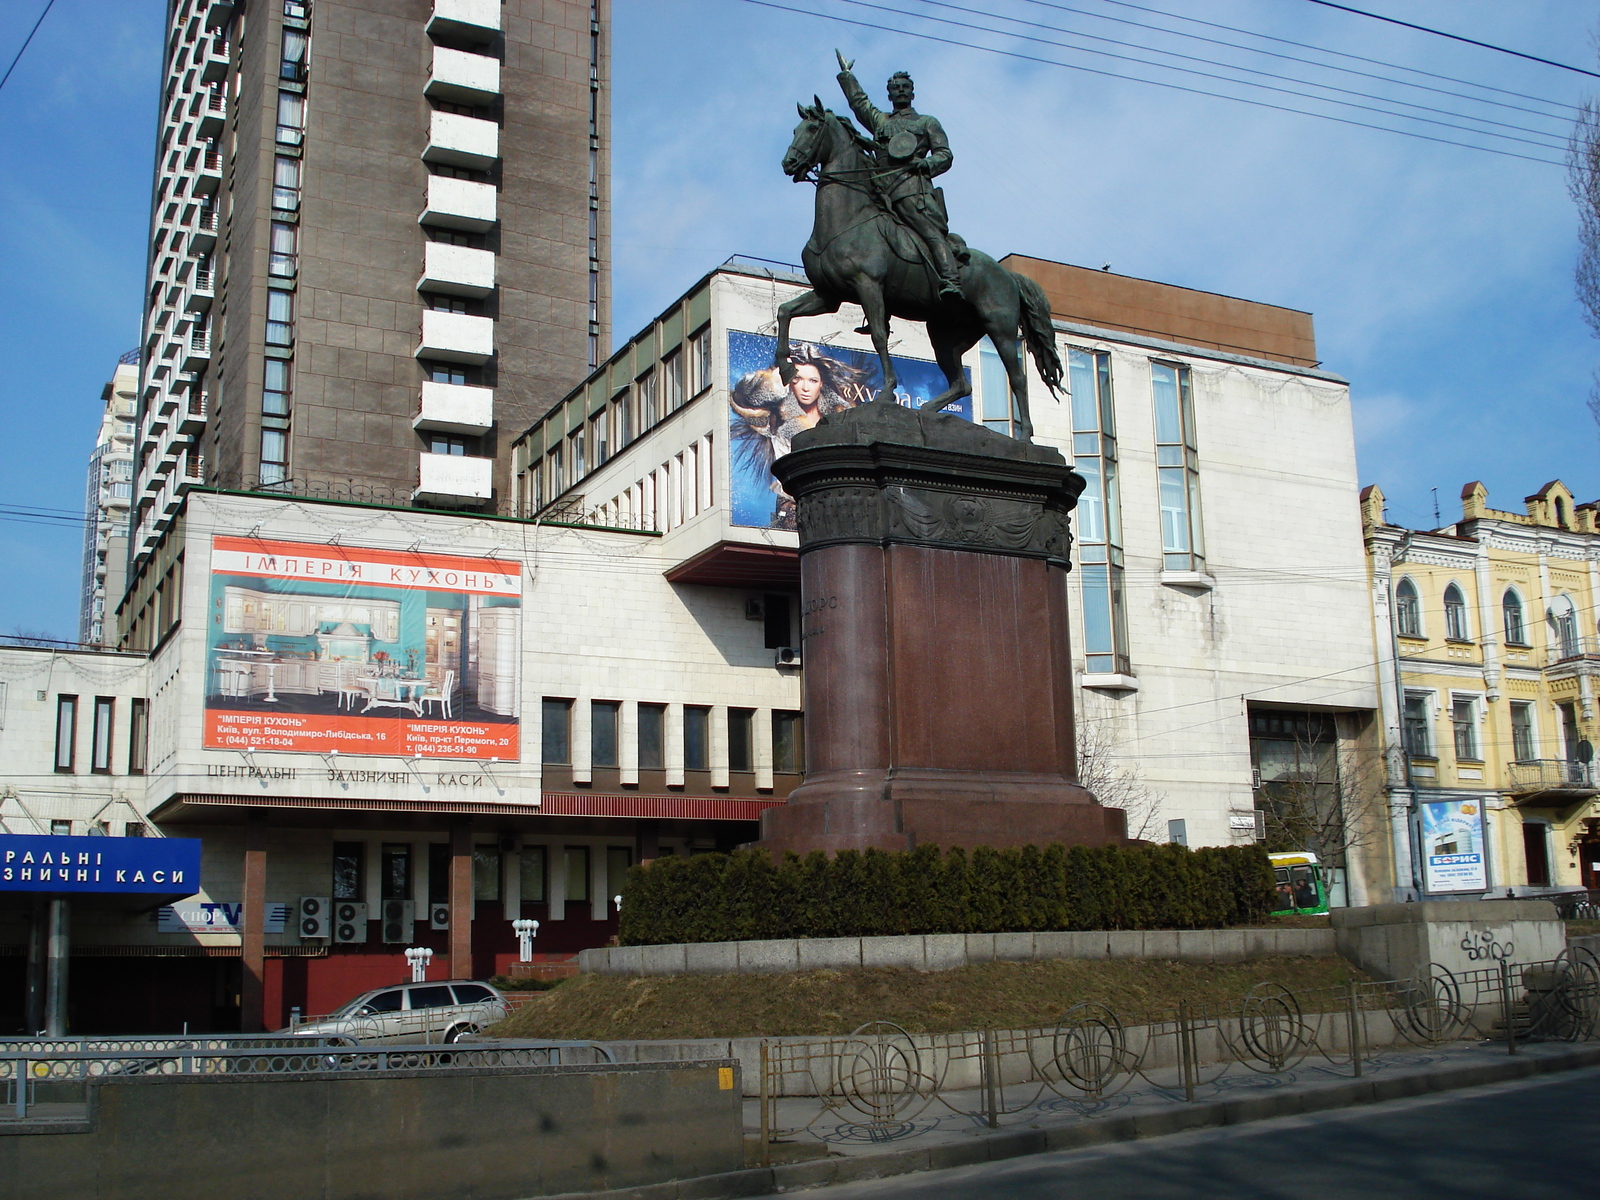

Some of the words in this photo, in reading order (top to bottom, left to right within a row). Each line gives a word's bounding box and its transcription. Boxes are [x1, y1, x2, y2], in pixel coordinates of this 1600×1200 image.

[245, 555, 362, 578] ІМПЕРІЯ
[390, 567, 494, 589] КУХОНЬ
[217, 725, 240, 735] Київ,
[242, 728, 262, 737] вул.
[264, 727, 374, 741] Володимиро-Либідська,
[375, 732, 386, 741] 16
[406, 734, 428, 743] Київ,
[430, 736, 452, 744] пр-кт
[454, 735, 497, 746] Перемоги,
[499, 738, 509, 746] 20
[226, 737, 248, 746] (044)
[250, 737, 293, 747] 521-18-04
[414, 744, 436, 754] (044)
[437, 745, 477, 754] 236-51-90
[207, 764, 296, 780] ЦЕНТРАЛЬНІ
[327, 769, 410, 785] ЗАЛІЗНИЧНІ
[437, 774, 483, 787] КАСИ
[5, 850, 102, 865] РАЛЬНІ
[1433, 855, 1478, 865] БОРИС
[3, 867, 100, 882] ЗНИЧНІ
[116, 869, 183, 883] КАСИ
[200, 903, 242, 925] TV
